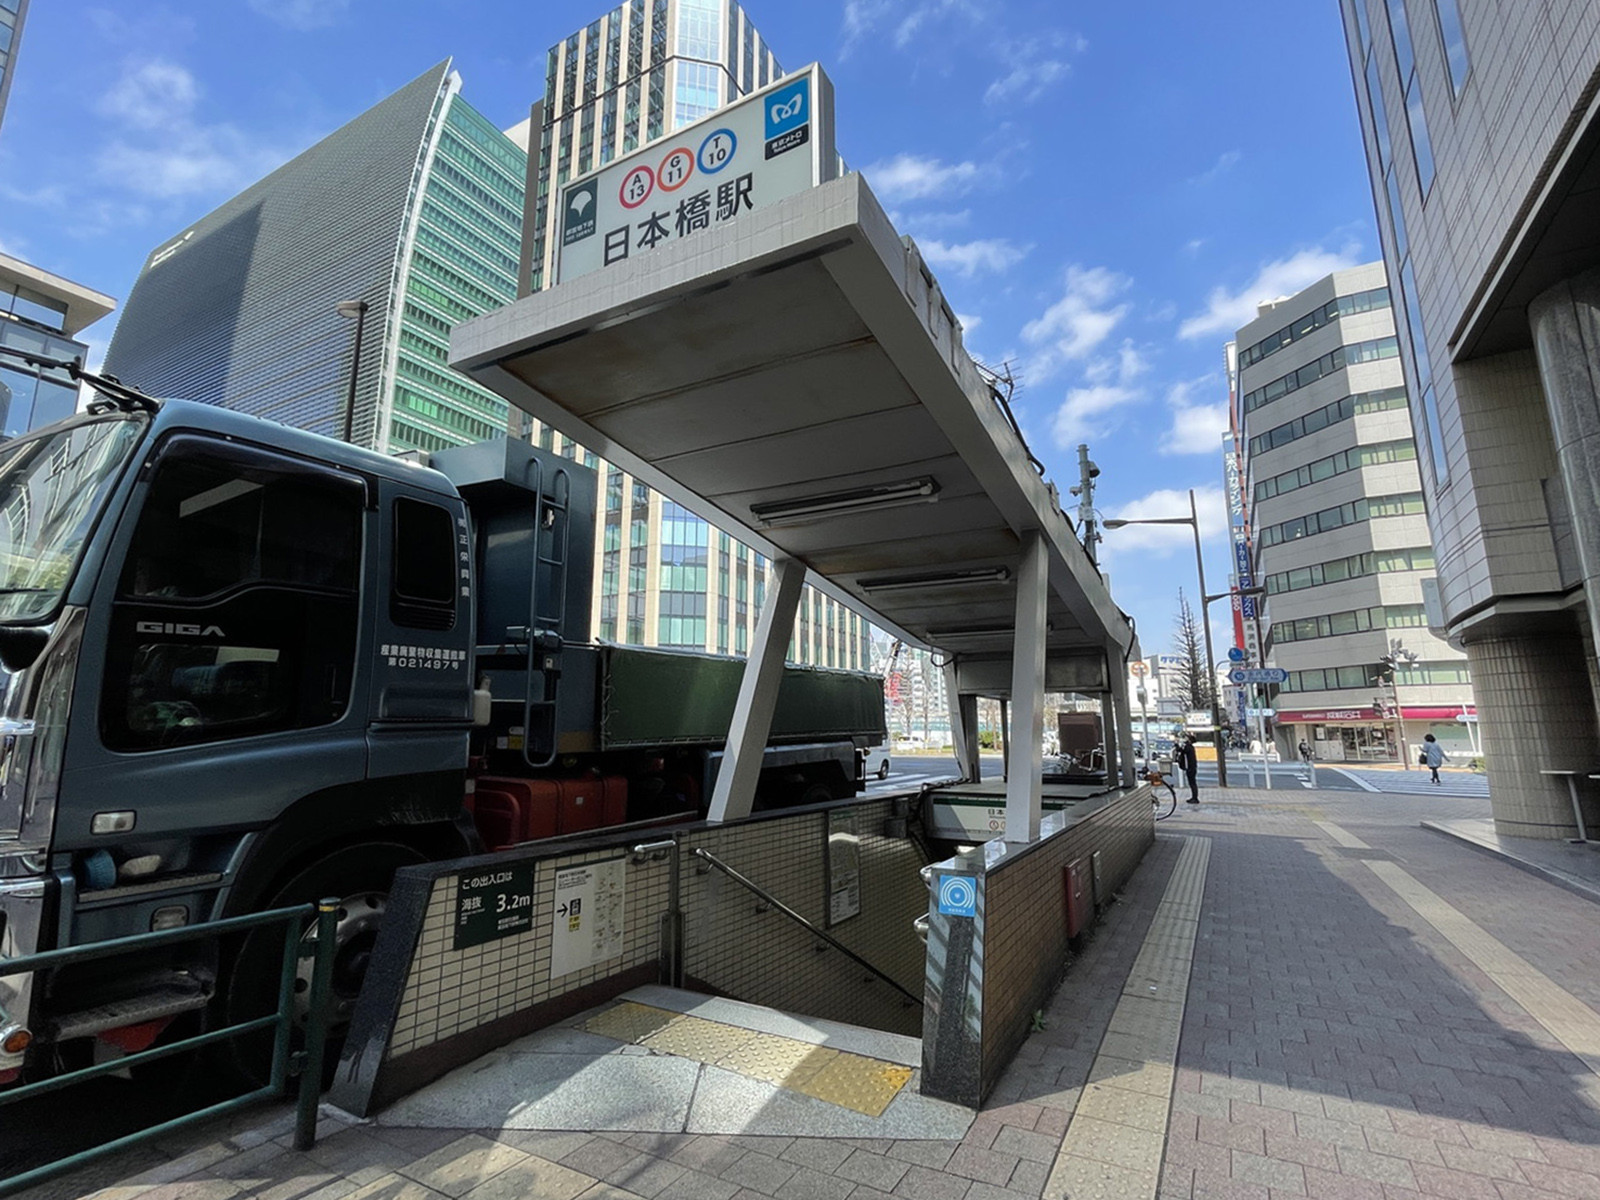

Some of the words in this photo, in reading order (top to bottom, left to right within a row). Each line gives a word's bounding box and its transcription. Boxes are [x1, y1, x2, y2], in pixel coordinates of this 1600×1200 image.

[712, 136, 722, 149] T
[669, 155, 681, 169] G
[708, 148, 727, 165] 10
[632, 173, 642, 185] A
[667, 167, 683, 183] 11
[628, 185, 646, 200] 13
[603, 172, 754, 267] 日本橋駅
[136, 621, 226, 637] GIGA
[461, 871, 513, 890] この出入口は
[461, 896, 482, 912] 海抜
[495, 893, 531, 913] 3.2m
